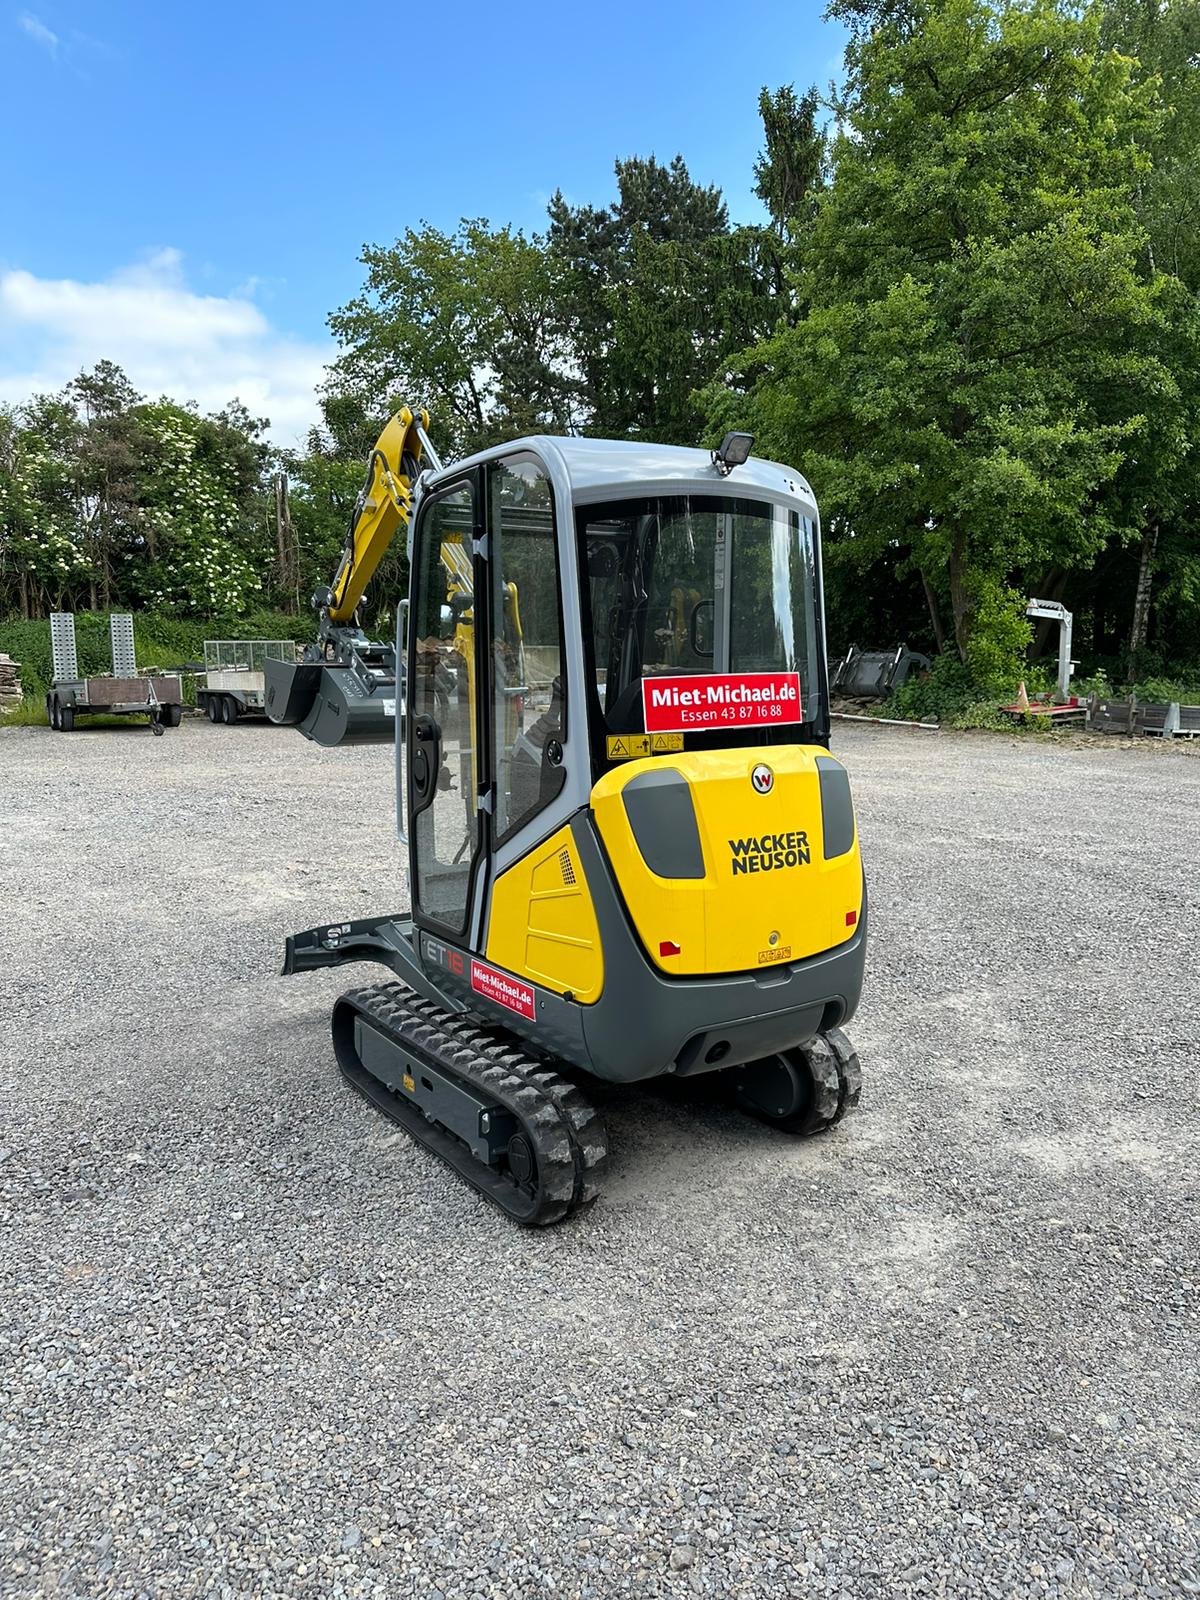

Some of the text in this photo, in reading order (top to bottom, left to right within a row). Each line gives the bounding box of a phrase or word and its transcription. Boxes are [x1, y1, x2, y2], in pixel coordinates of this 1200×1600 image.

[652, 683, 796, 707] Miet-Michael.de
[681, 705, 782, 722] Essen 43 87 16 88
[728, 831, 809, 857] WACKER
[732, 847, 811, 876] NEUSON
[474, 967, 532, 1005] Miet-Michael.de
[481, 984, 523, 1011] Essen 43 87 16 88
